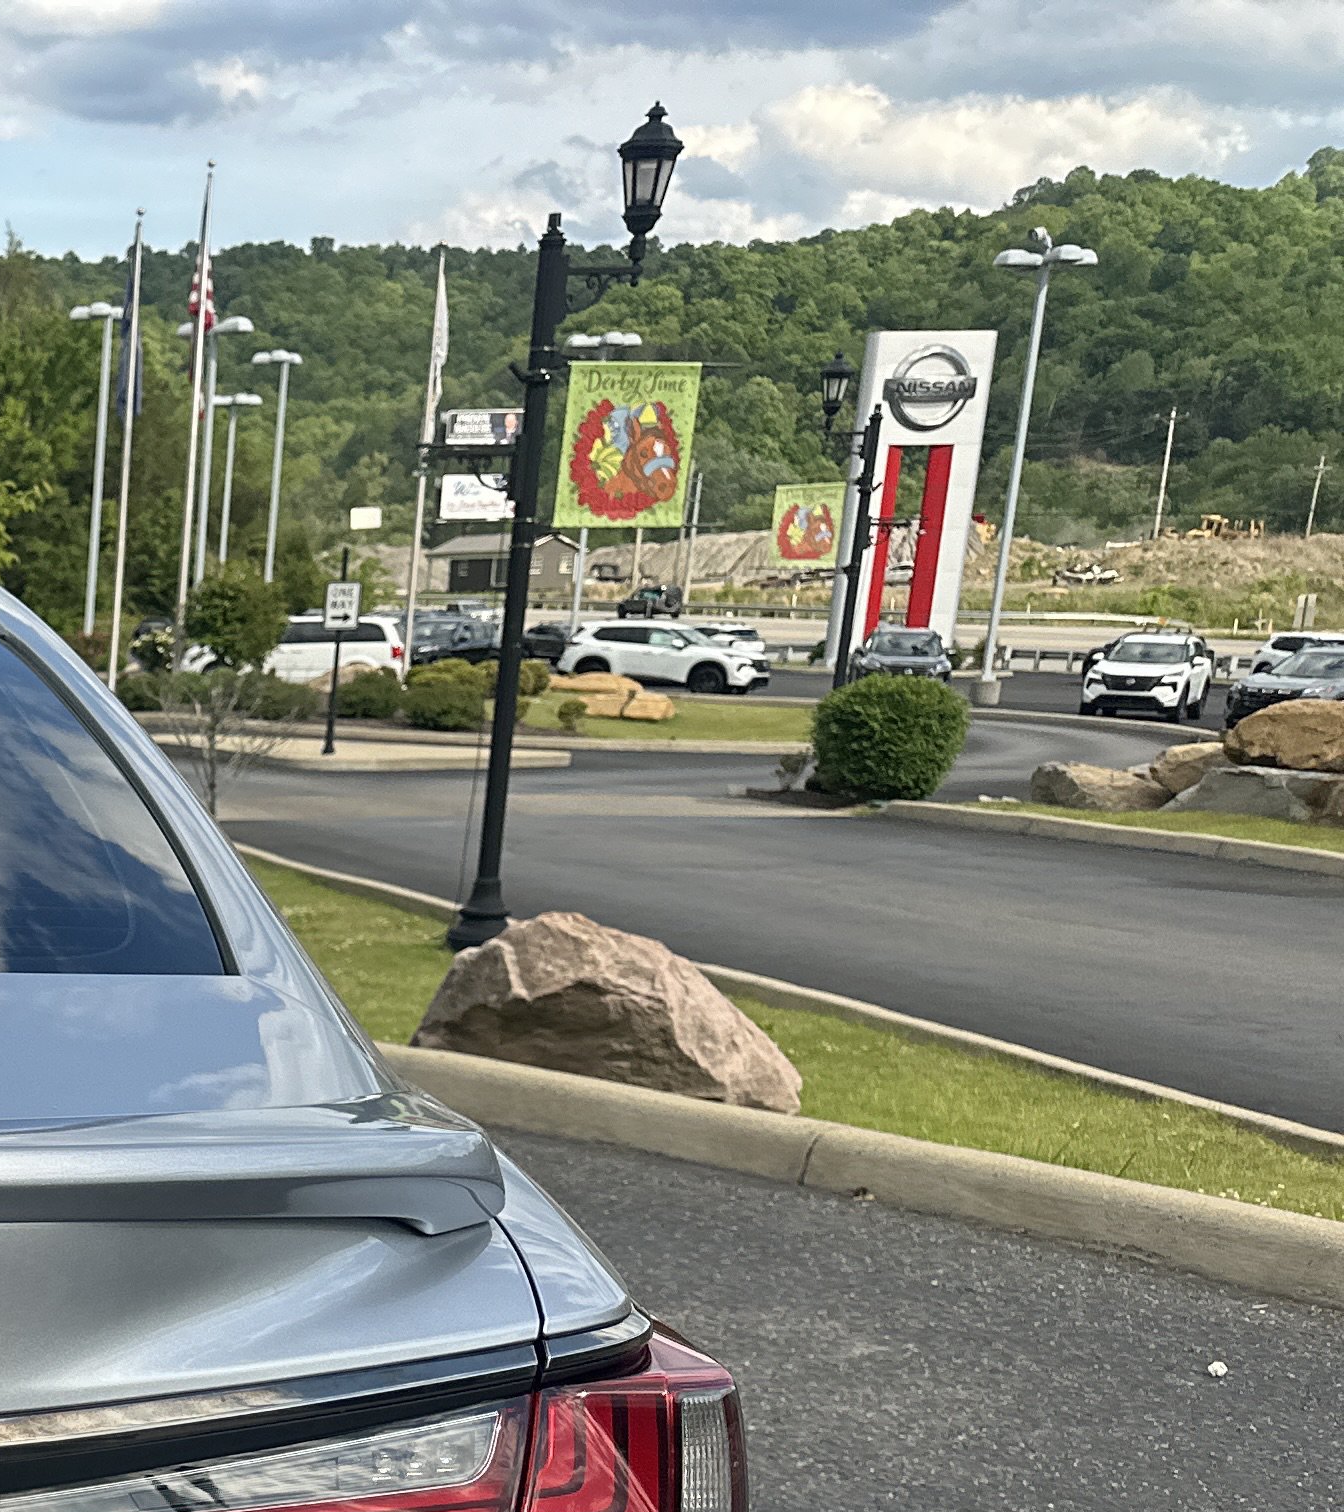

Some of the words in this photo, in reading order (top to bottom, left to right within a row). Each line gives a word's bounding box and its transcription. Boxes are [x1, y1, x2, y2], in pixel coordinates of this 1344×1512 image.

[587, 368, 642, 403] Derby
[644, 368, 688, 394] Time
[895, 381, 971, 393] NISSAN
